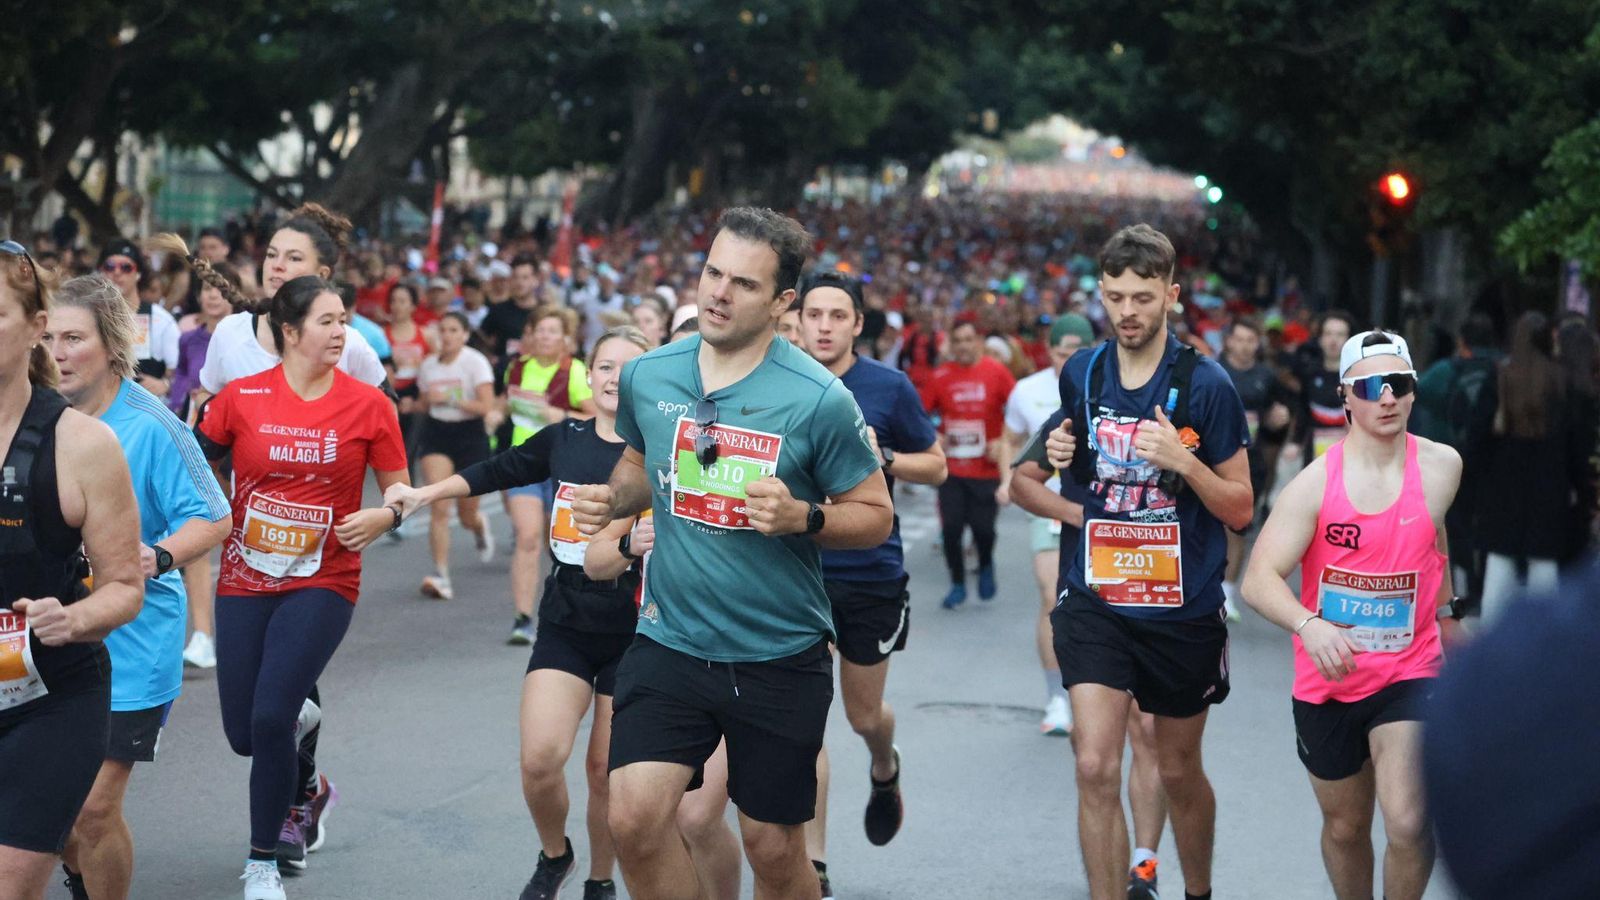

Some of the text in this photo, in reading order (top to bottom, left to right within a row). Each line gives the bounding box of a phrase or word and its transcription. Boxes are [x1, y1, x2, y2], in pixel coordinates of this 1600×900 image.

[657, 400, 688, 417] epm
[272, 425, 321, 438] GENERALI
[705, 428, 772, 454] GENERALI
[269, 444, 320, 464] MÁLAGA
[267, 503, 325, 522] GENERALI
[734, 506, 746, 514] 42
[260, 525, 306, 547] 16911
[1113, 526, 1172, 540] GENERALI
[1326, 523, 1361, 550] SR
[1113, 552, 1154, 569] 2201
[1348, 574, 1410, 590] GENERALI
[1340, 598, 1395, 617] 17846
